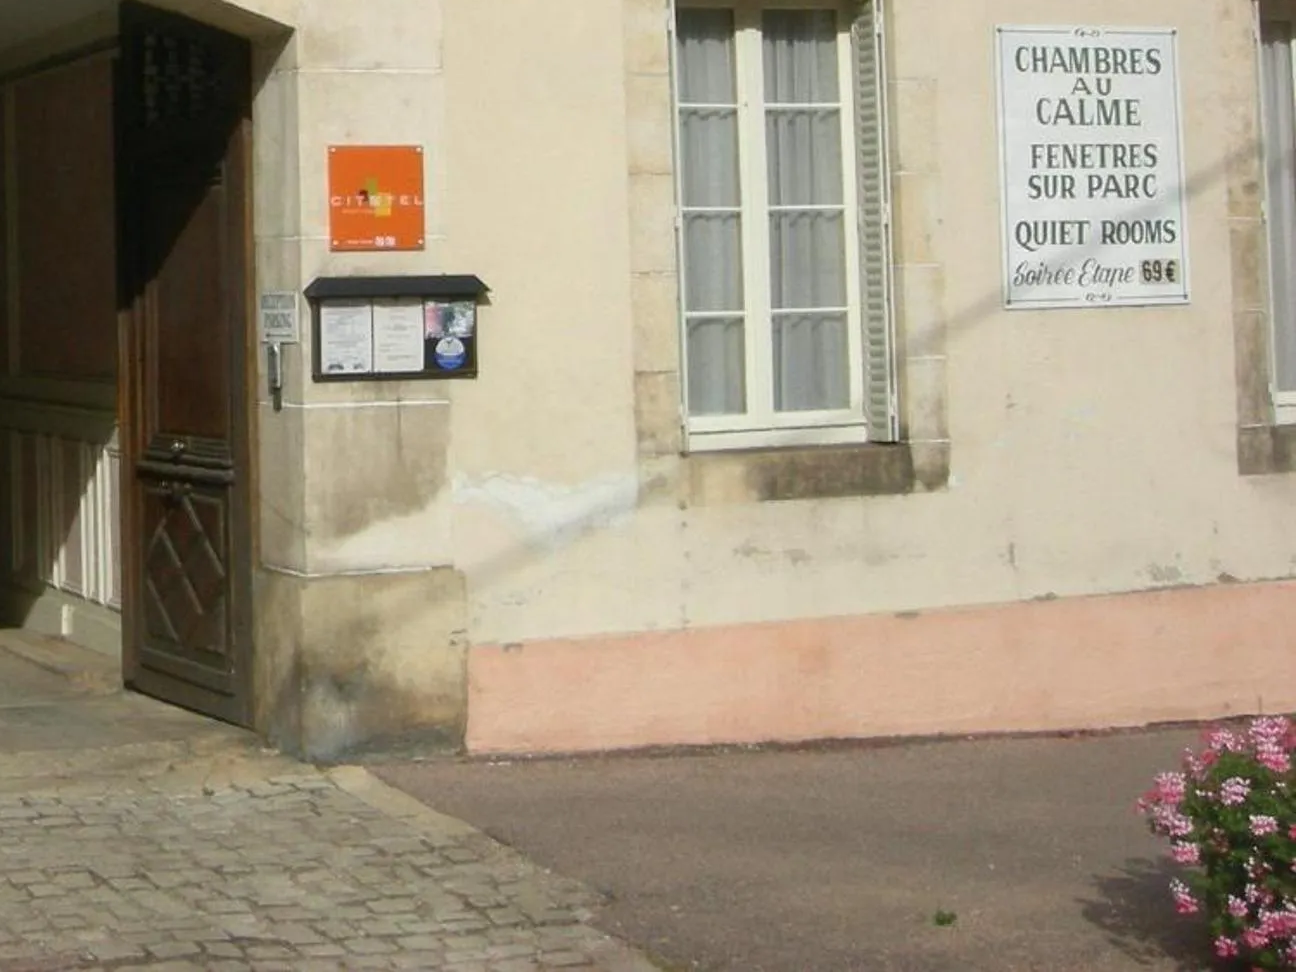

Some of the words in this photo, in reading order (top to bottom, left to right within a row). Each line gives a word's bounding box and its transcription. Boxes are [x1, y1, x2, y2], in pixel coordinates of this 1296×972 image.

[1015, 46, 1162, 75] CHAMBRES
[1071, 77, 1112, 96] AU
[1036, 97, 1141, 126] CALME
[1030, 143, 1158, 169] FENETRES
[1027, 174, 1075, 199] SUR
[1087, 174, 1157, 199] PARC
[1015, 220, 1091, 252] QUIET
[1100, 220, 1176, 245] ROOMS
